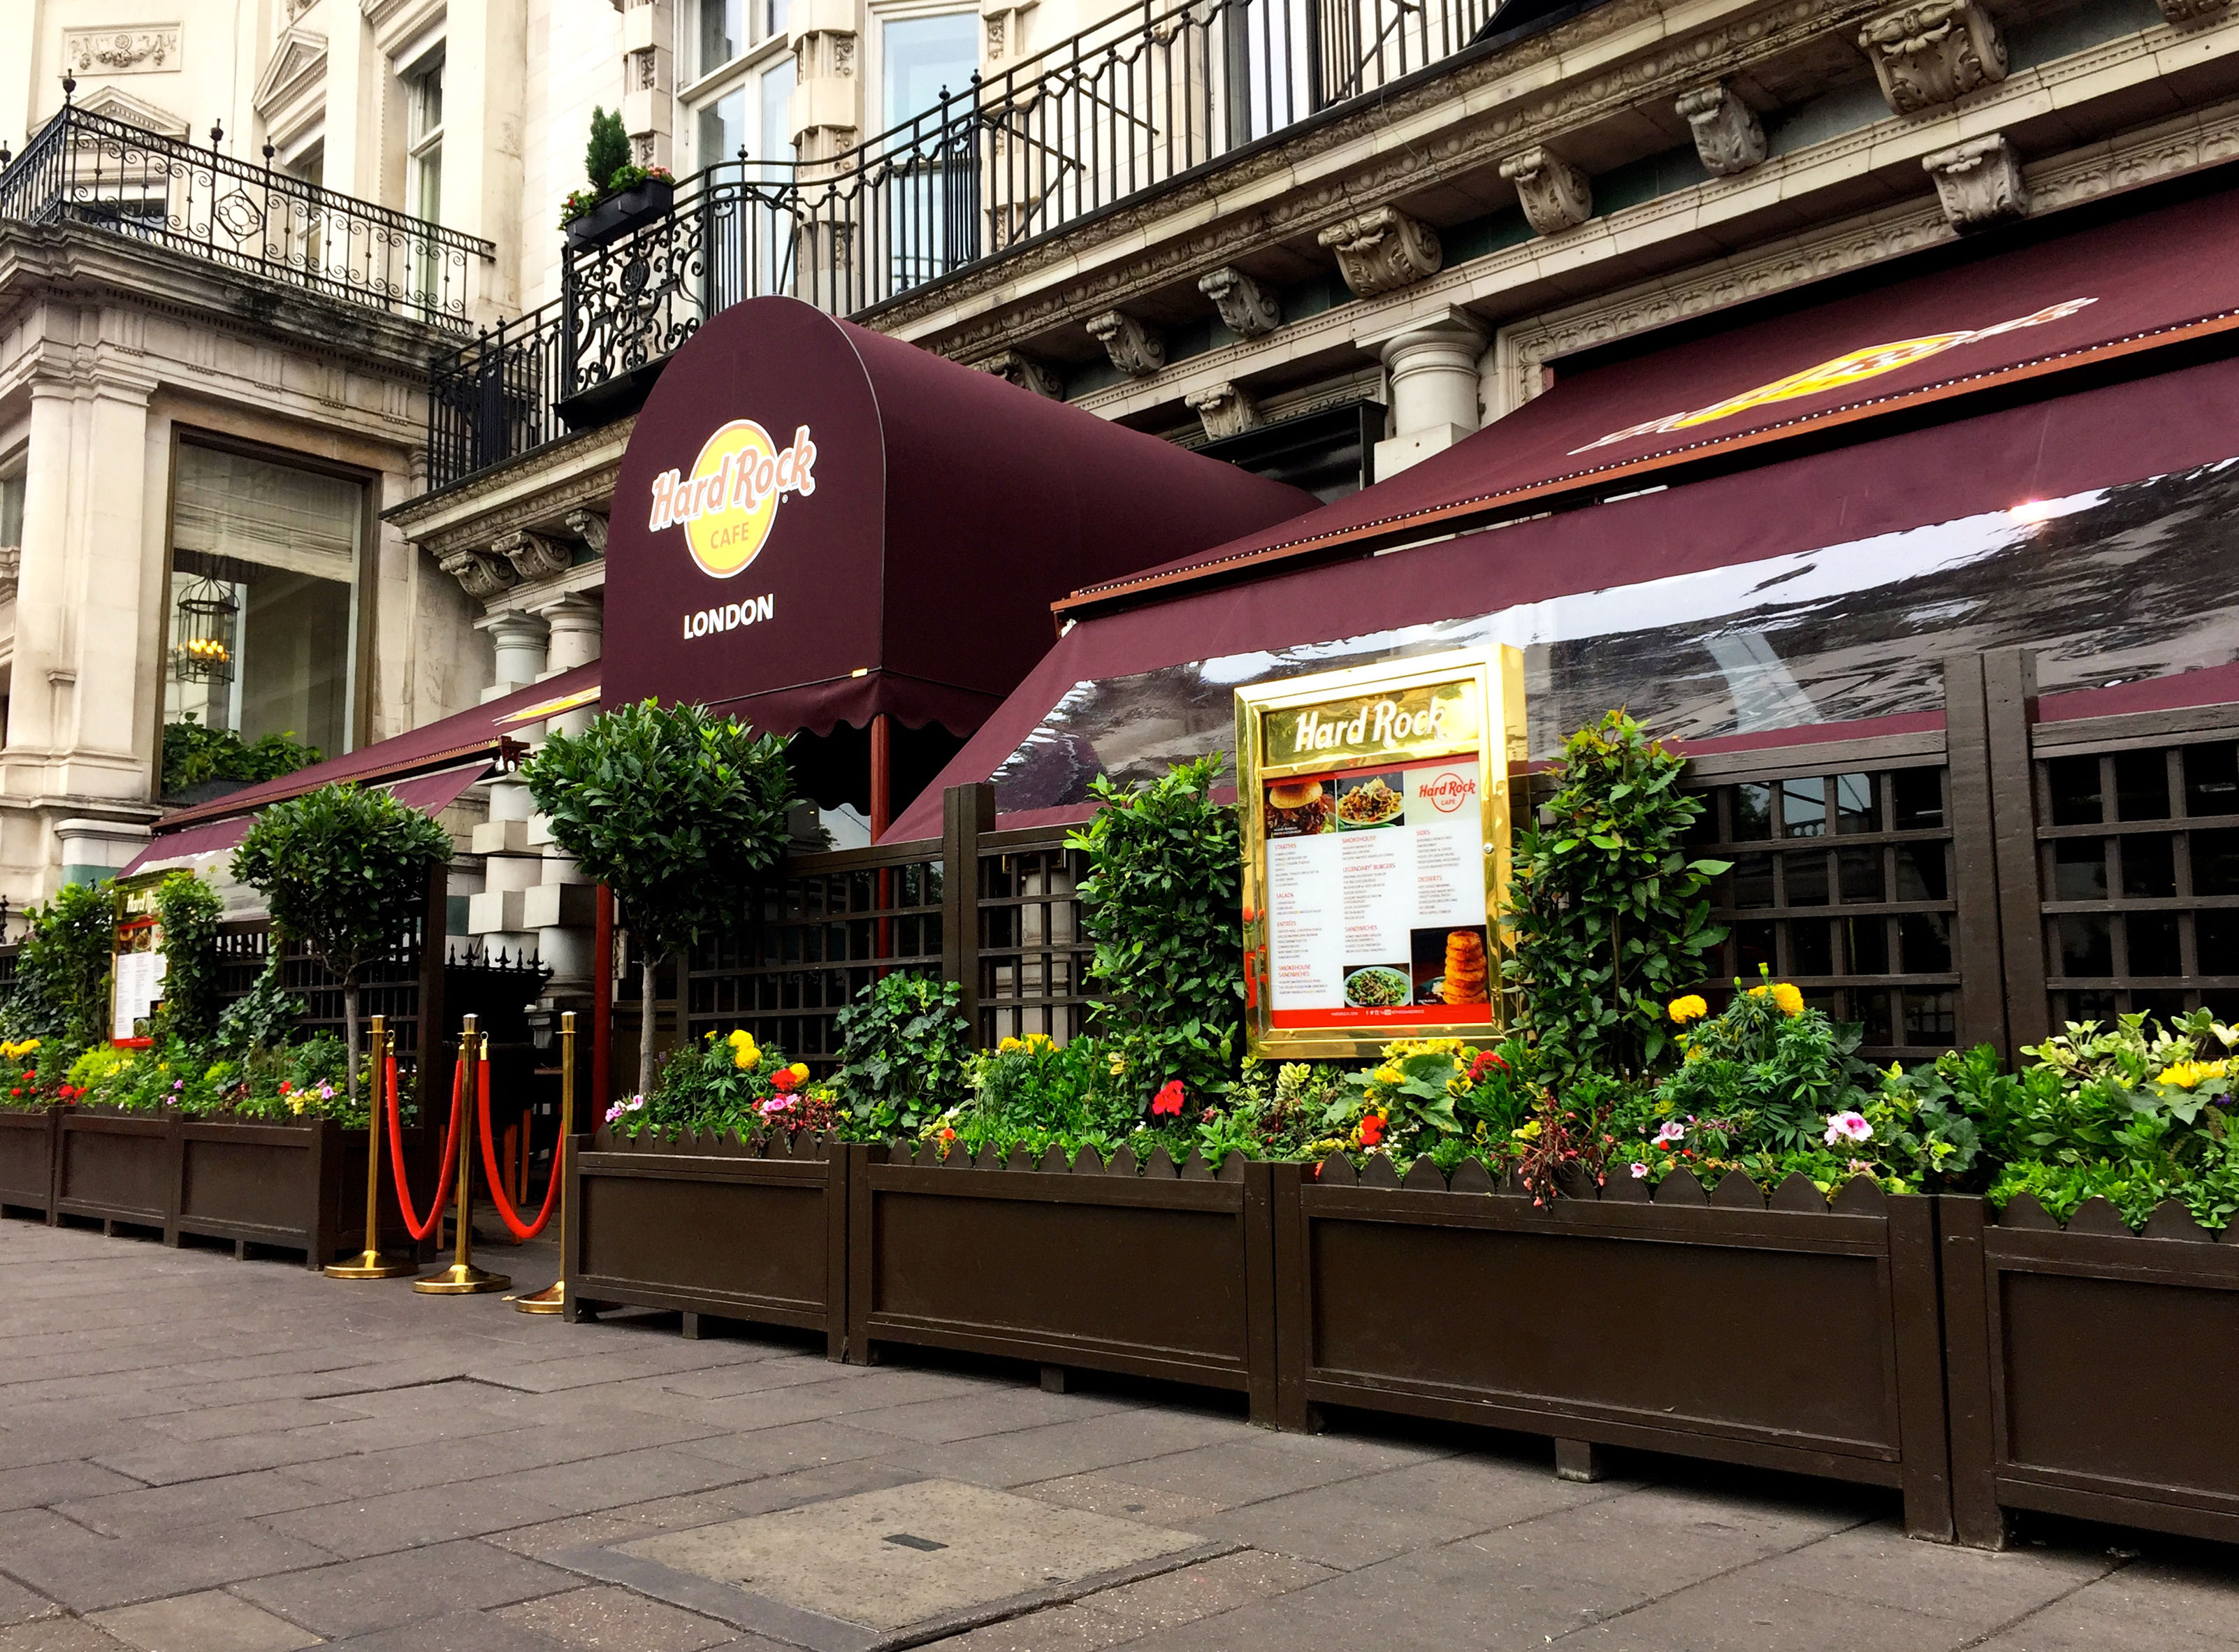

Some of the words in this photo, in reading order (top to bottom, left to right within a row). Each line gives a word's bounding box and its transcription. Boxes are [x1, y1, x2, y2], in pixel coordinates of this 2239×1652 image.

[649, 456, 731, 532] Hard
[732, 425, 817, 514] Rock
[710, 522, 749, 549] CAFE
[683, 593, 774, 639] LONDON
[1294, 705, 1369, 752] Hard
[1372, 695, 1447, 748] Rock
[1419, 783, 1447, 797] Hard
[1449, 778, 1476, 796] Rock
